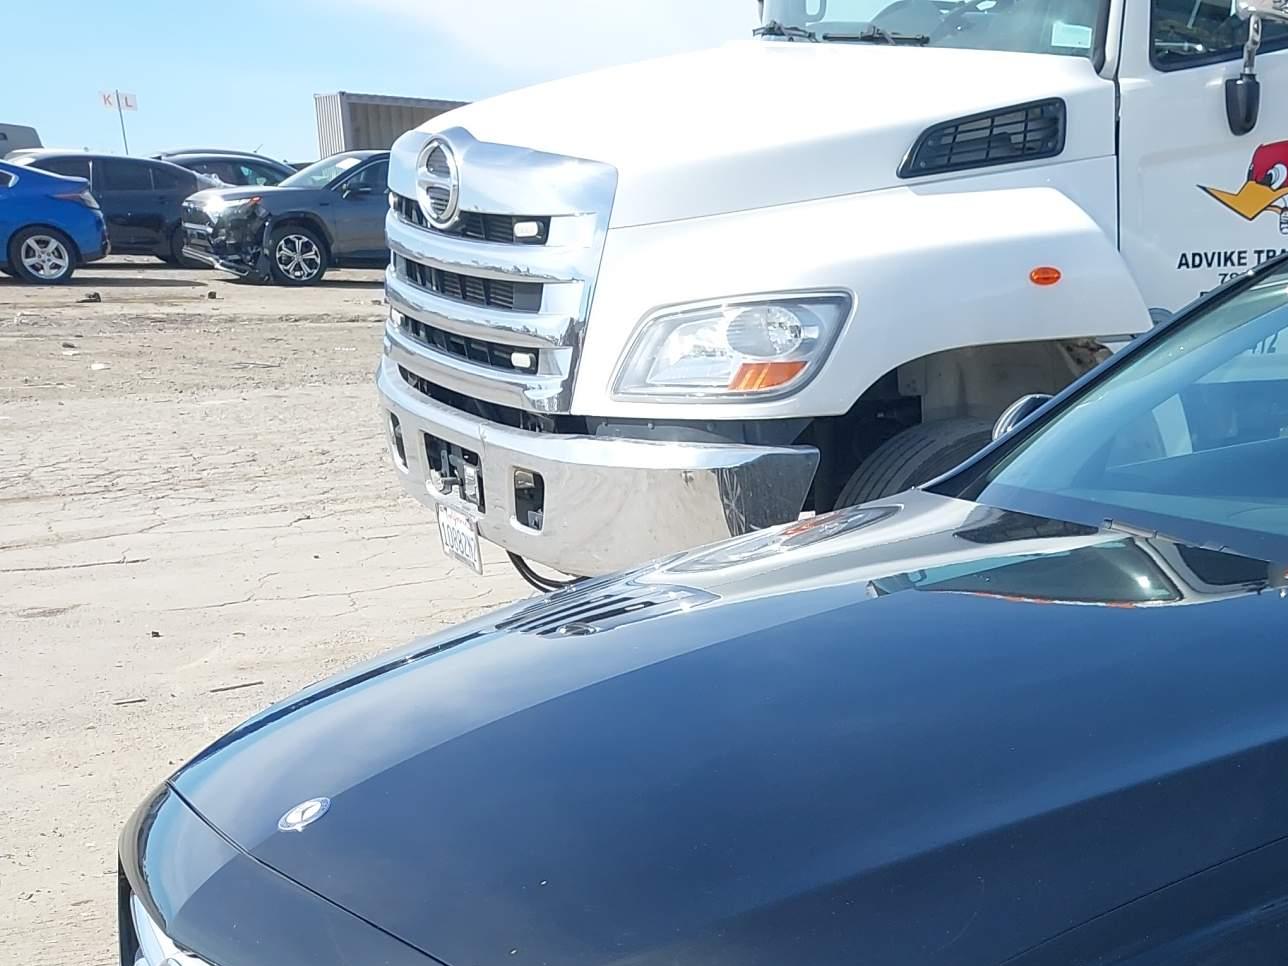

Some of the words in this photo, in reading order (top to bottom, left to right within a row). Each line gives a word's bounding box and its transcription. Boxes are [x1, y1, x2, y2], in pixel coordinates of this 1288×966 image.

[103, 94, 113, 106] K
[125, 96, 133, 108] L
[1177, 250, 1247, 269] ADVIKE
